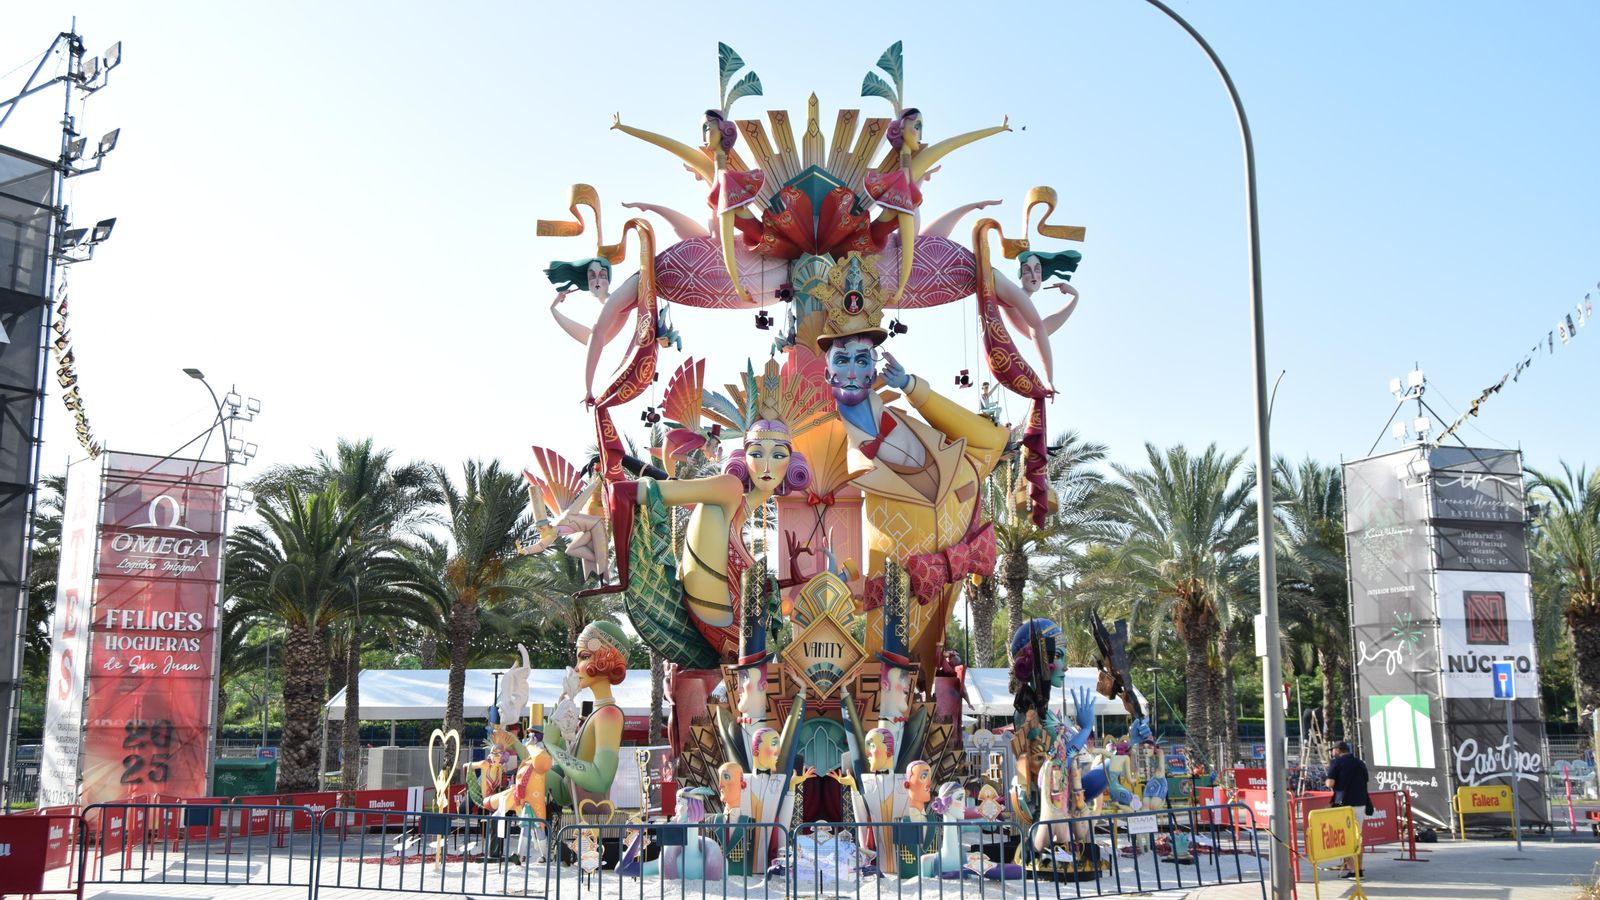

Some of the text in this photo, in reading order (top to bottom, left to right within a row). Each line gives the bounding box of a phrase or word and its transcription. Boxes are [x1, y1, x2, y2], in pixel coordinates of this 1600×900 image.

[111, 534, 210, 557] OMEGA
[162, 560, 203, 576] Integral
[106, 608, 203, 631] FELICES
[105, 635, 201, 652] HOGUERAS
[803, 641, 845, 658] VANITY
[103, 655, 201, 674] de San Juan
[1448, 651, 1531, 673] NÚCO
[122, 719, 174, 749] 20
[120, 753, 170, 784] 25
[1472, 793, 1500, 807] Fallera
[1320, 822, 1346, 850] Fallera
